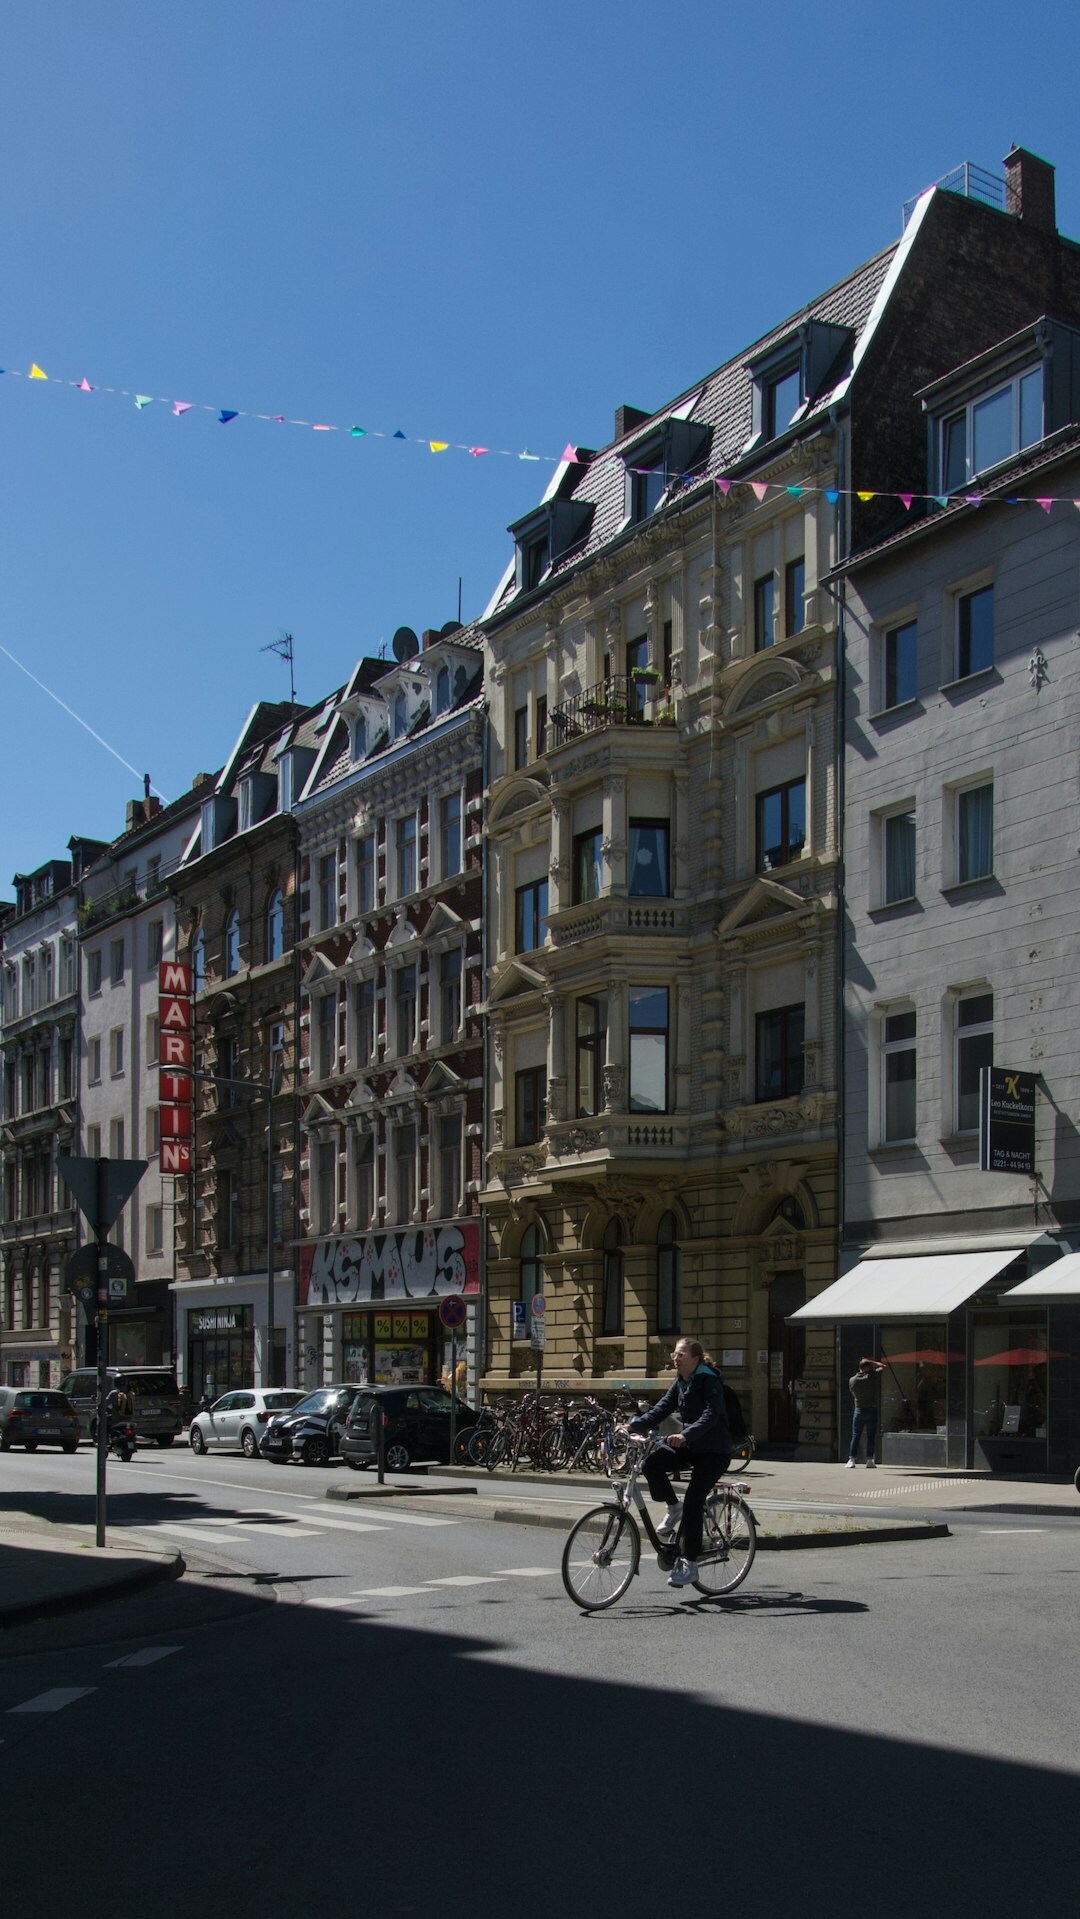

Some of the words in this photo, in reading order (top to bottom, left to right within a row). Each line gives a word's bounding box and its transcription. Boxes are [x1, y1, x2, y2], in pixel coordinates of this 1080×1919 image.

[1004, 1074, 1021, 1100] K
[991, 1099, 1001, 1108] Leo
[1001, 1100, 1034, 1112] Kuckelkorn
[993, 1149, 1005, 1158] TAG
[1005, 1150, 1010, 1158] &
[1010, 1151, 1031, 1160] NACHT
[199, 1315, 217, 1330] SUSHI
[217, 1313, 236, 1329] NINJA
[377, 1319, 389, 1333] %
[395, 1319, 408, 1333] %
[413, 1319, 426, 1333] %
